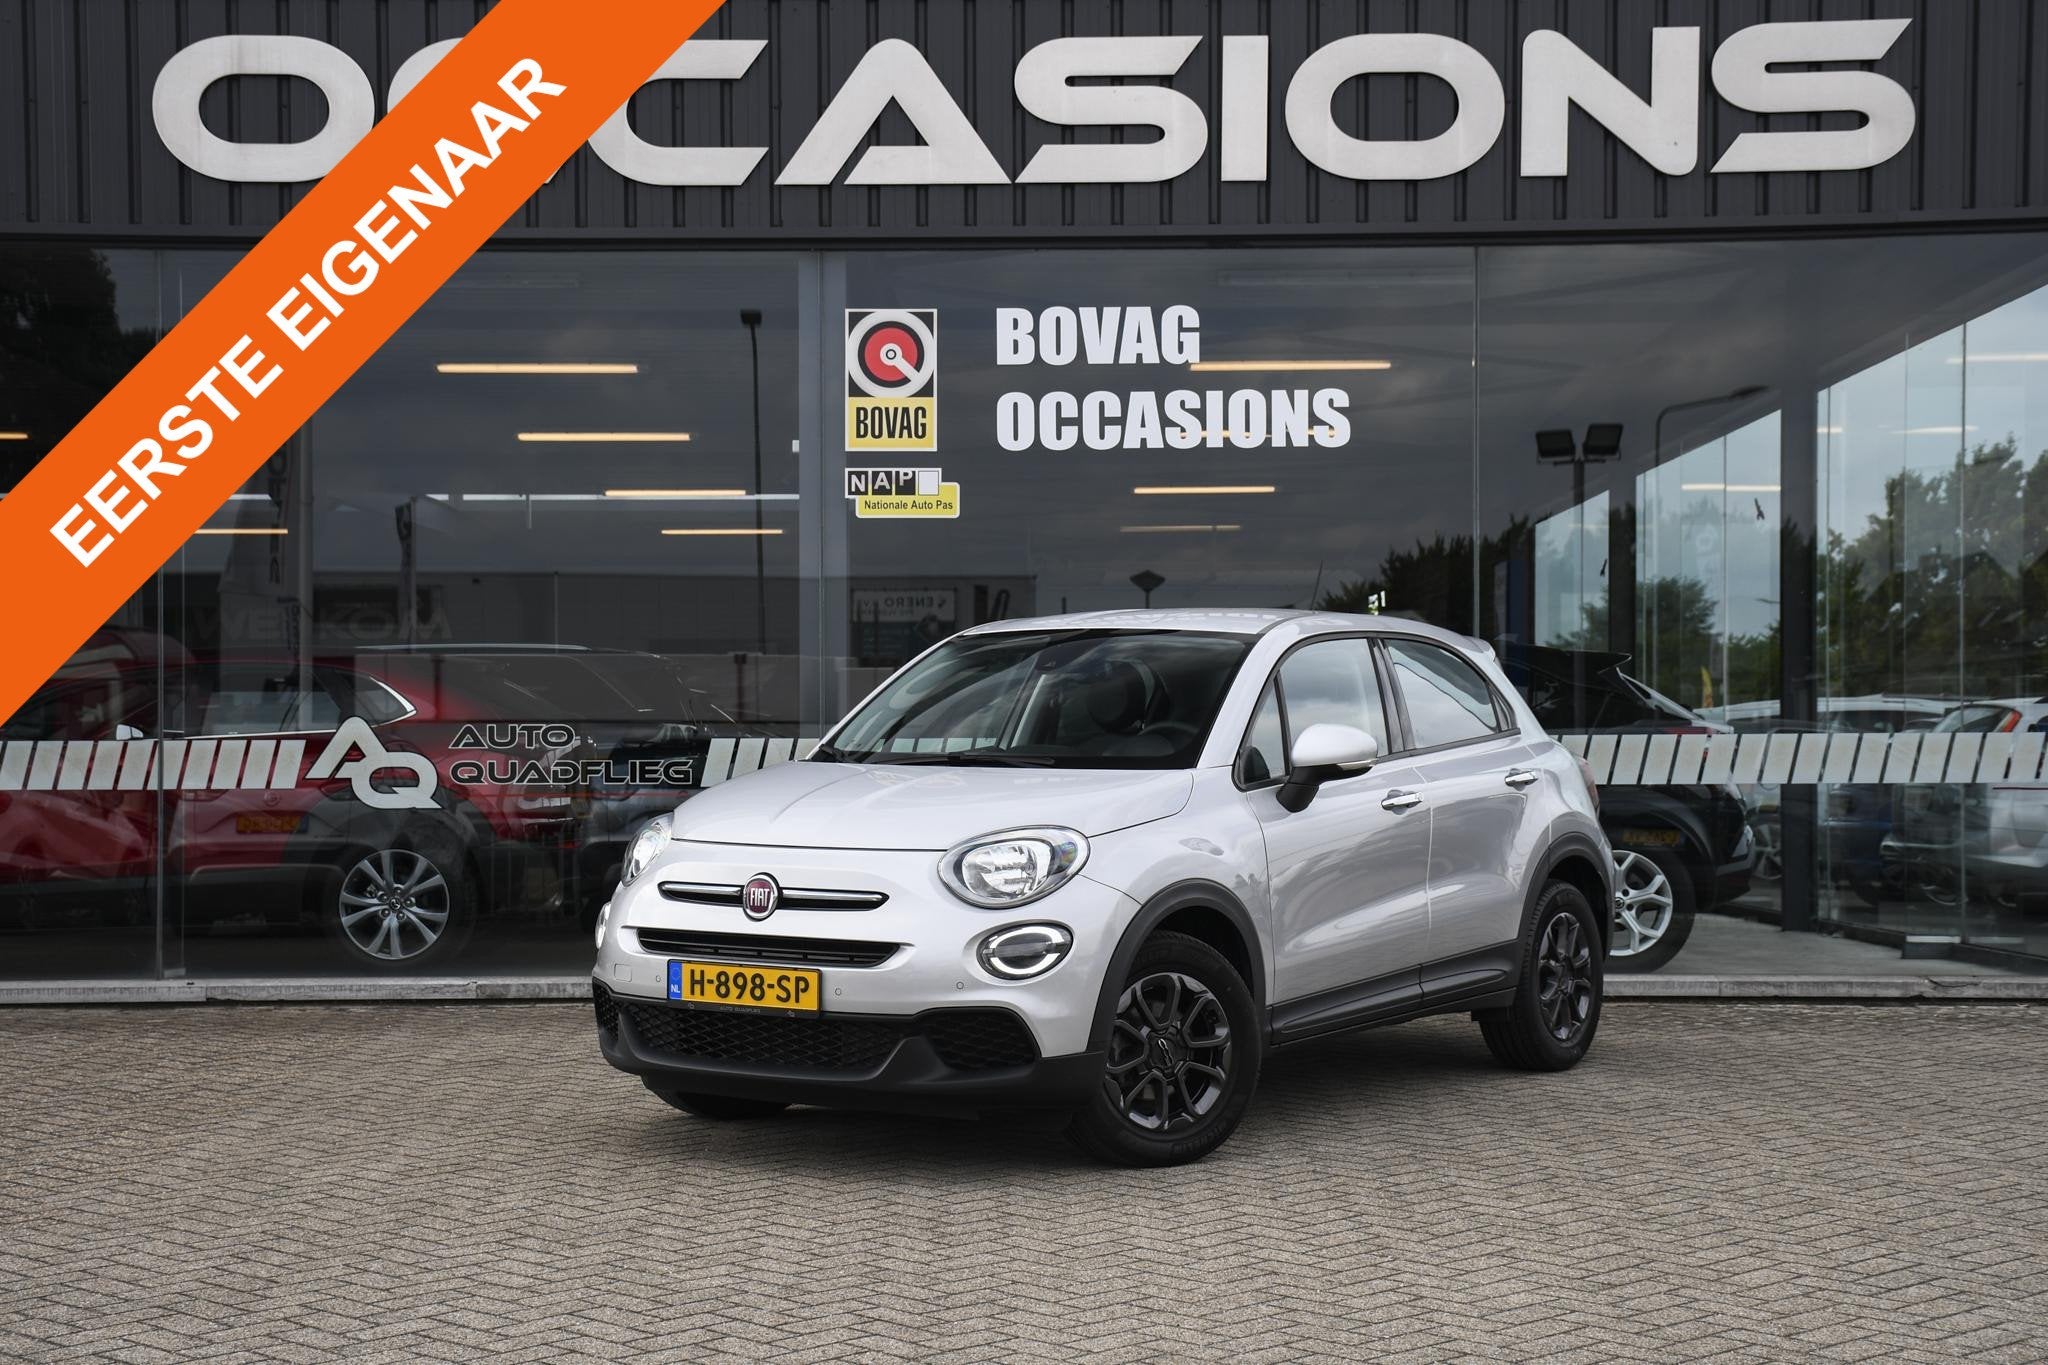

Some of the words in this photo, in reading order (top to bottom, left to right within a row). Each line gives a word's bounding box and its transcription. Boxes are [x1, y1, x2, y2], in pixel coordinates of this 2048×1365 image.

[152, 18, 1916, 186] OCASIONS
[996, 304, 1200, 366] BOVAG
[855, 405, 927, 440] BOVAG
[996, 388, 1351, 452] OCCASIONS
[864, 499, 909, 510] Nationale
[911, 499, 934, 510] Auto
[936, 499, 953, 510] Pas
[448, 723, 577, 749] AUTO
[448, 759, 694, 786] QUADFLIEG
[750, 887, 770, 907] FIAT
[670, 983, 681, 994] NL
[689, 968, 810, 1004] H-898-SP
